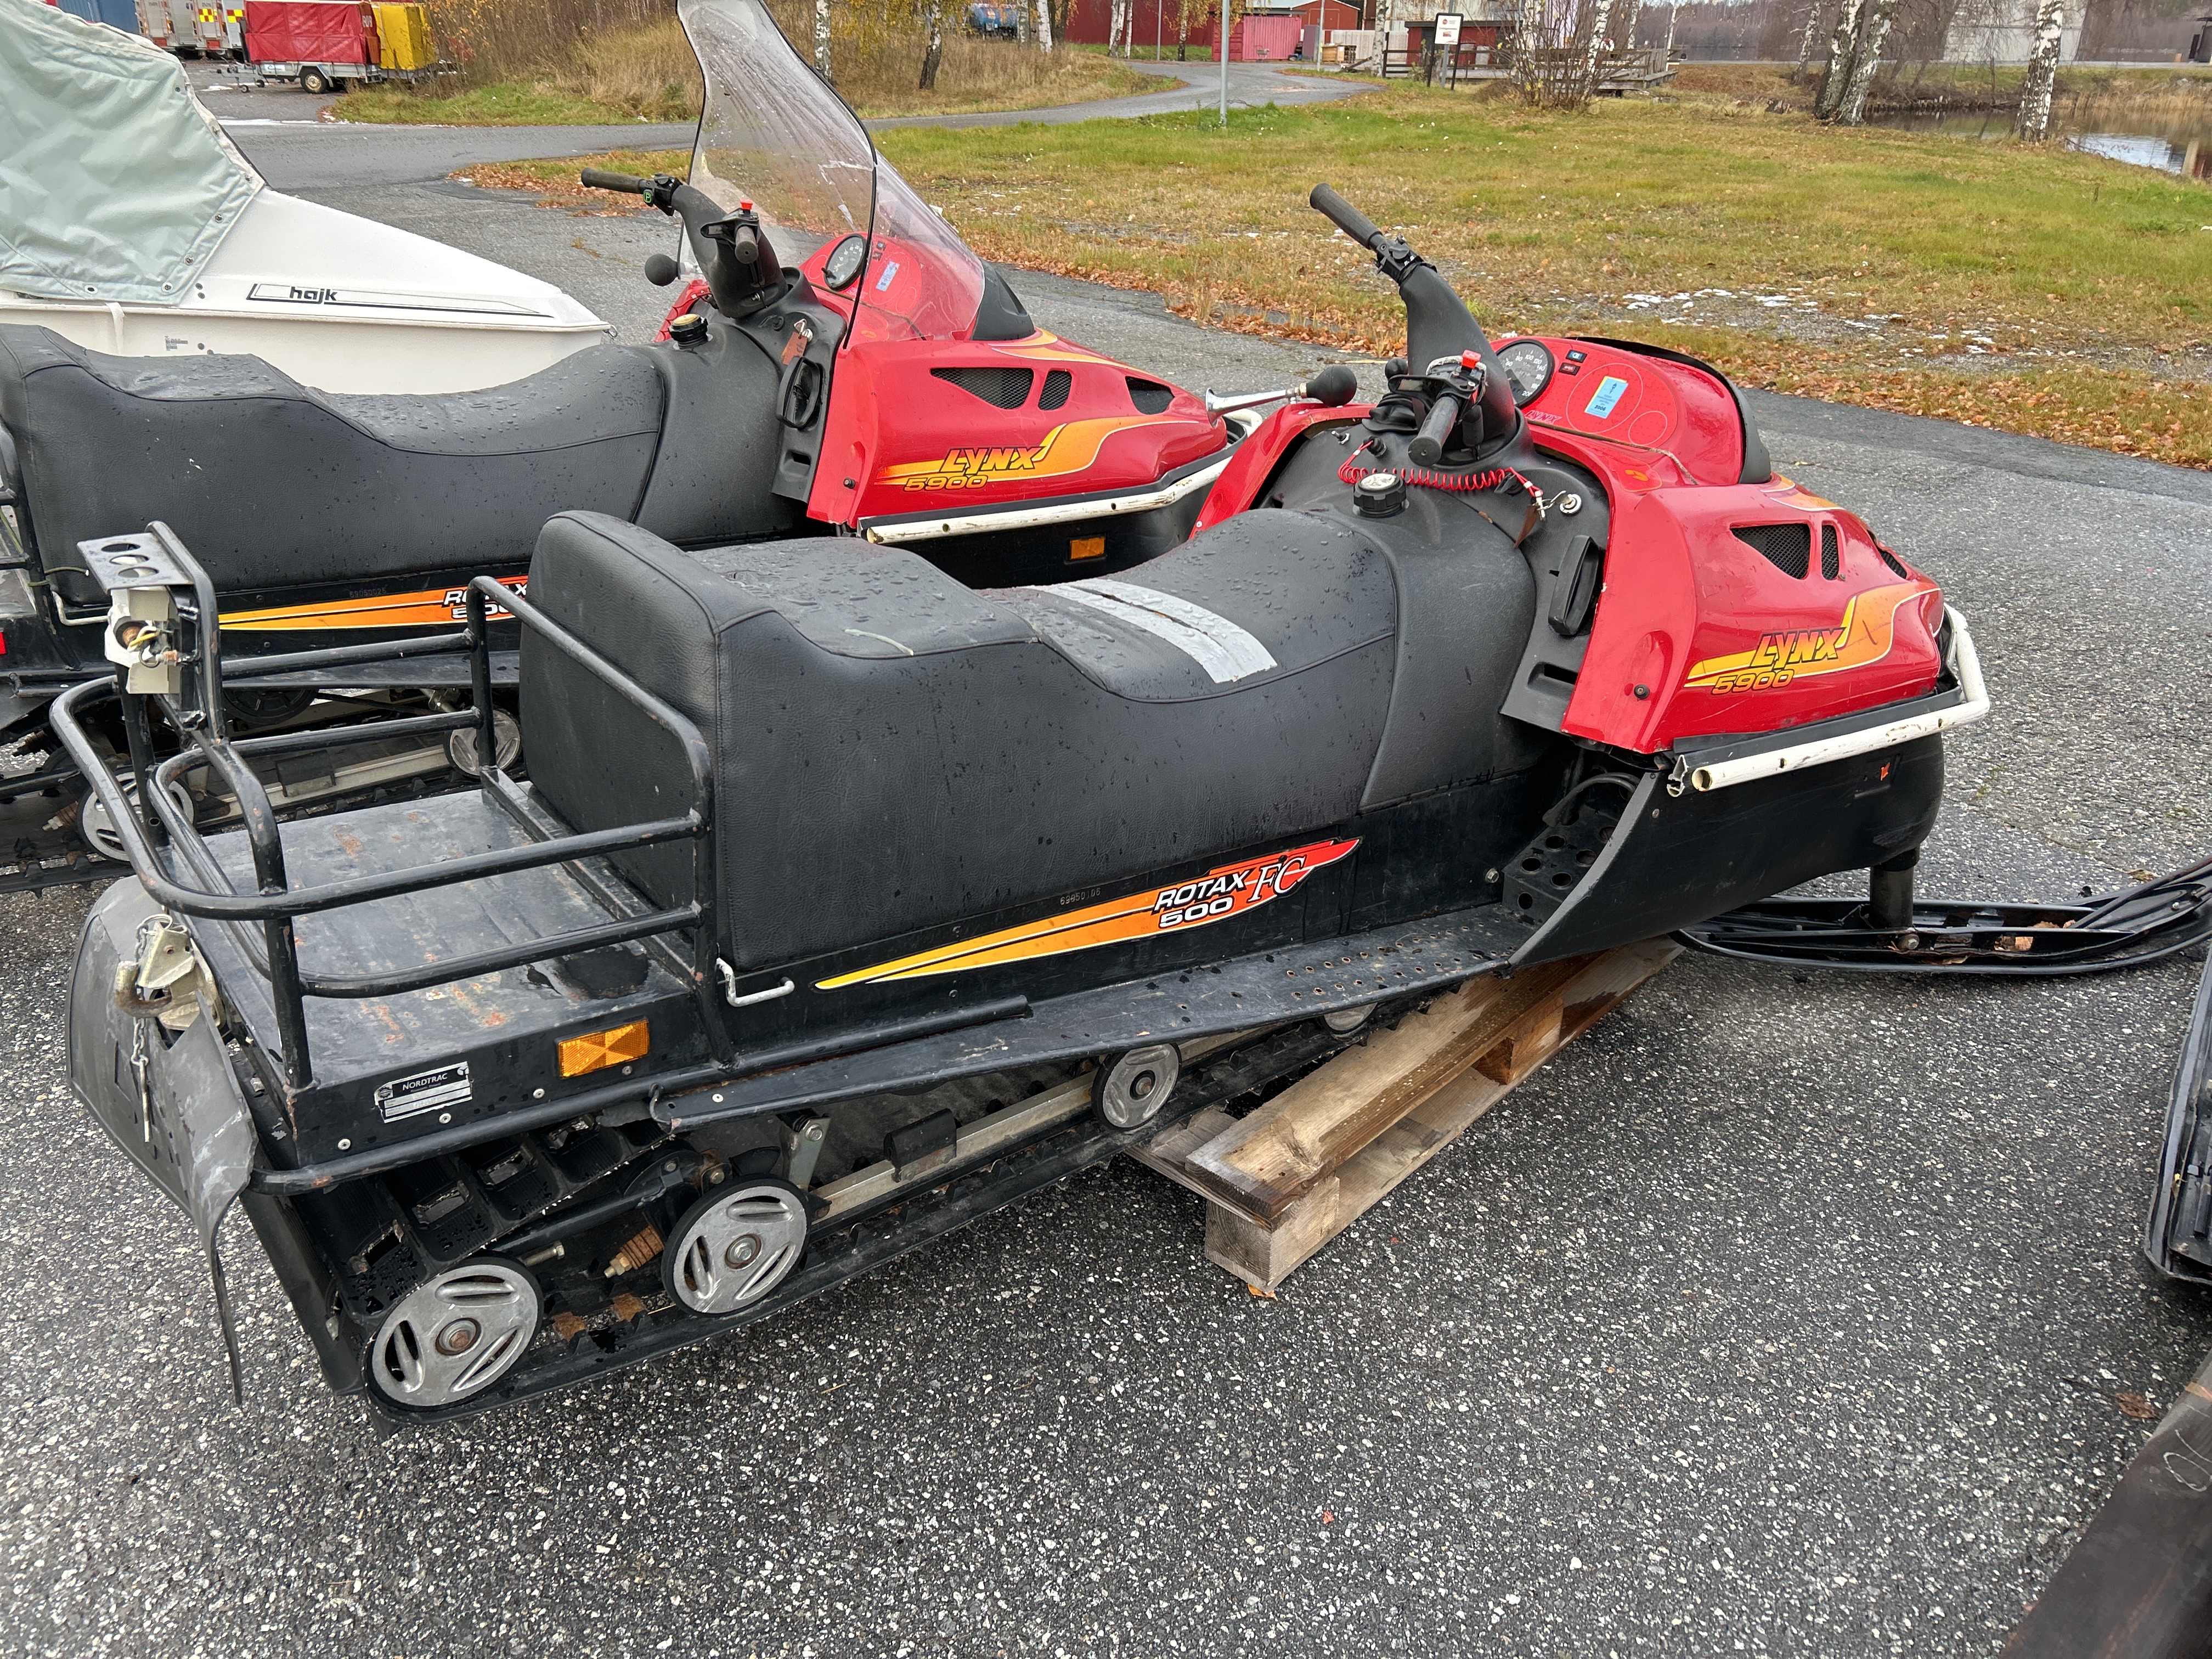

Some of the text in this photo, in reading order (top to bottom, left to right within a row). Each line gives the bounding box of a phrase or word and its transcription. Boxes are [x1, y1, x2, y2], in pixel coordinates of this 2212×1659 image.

[289, 286, 338, 304] hajk
[1524, 410, 1562, 425] LYNX
[939, 446, 1046, 476] LYNX
[903, 475, 988, 492] 5900
[1748, 627, 1847, 672] LYNX
[1711, 669, 1795, 695] 5900
[1153, 855, 1307, 912] ROTAX FC
[1159, 896, 1233, 928] 500
[403, 1073, 448, 1091] NORDTRAC
